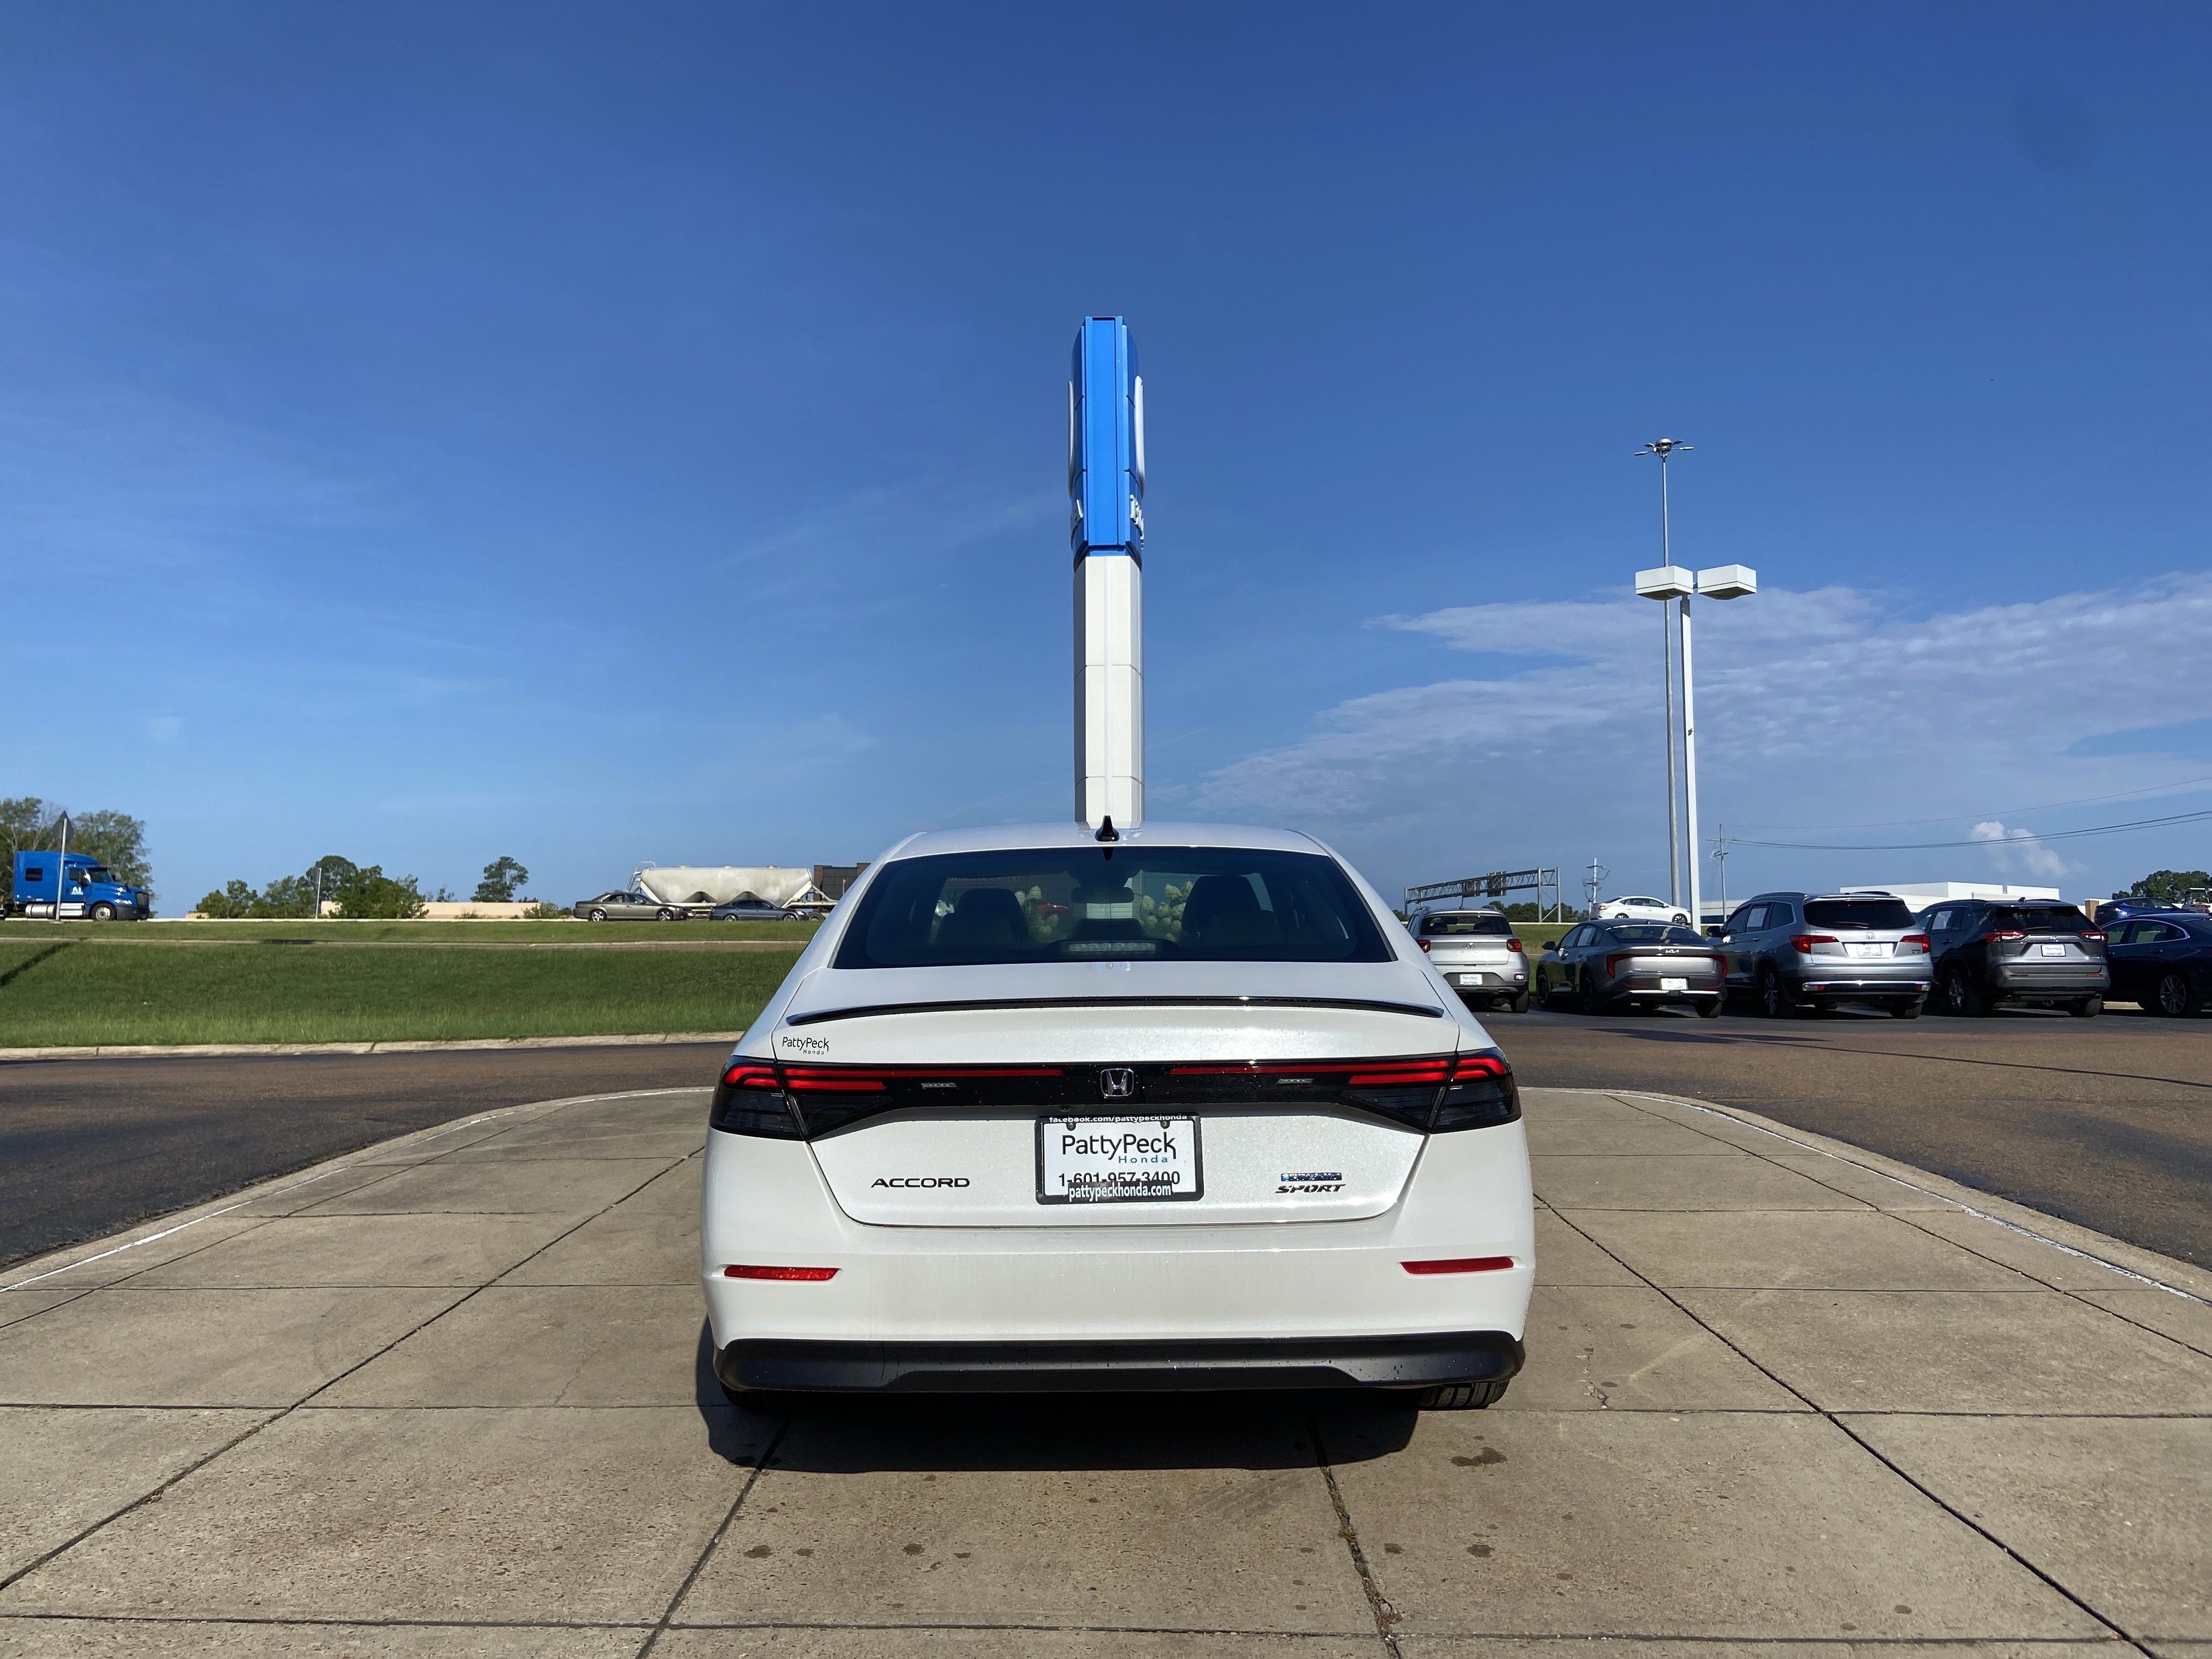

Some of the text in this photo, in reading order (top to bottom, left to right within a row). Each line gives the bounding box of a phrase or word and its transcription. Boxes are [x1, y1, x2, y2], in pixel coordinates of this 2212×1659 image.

[782, 1036, 830, 1052] PattyPeck
[1049, 1114, 1187, 1124] facebook.com/pattypeckhonda
[1062, 1132, 1176, 1160] PattyPeck
[1119, 1155, 1168, 1164] Honda
[871, 1178, 970, 1188] ACCORD
[1059, 1171, 1180, 1187] 1-601-957-3400
[1069, 1182, 1172, 1201] pattypeckhonda.com
[1275, 1184, 1346, 1193] SPORT
